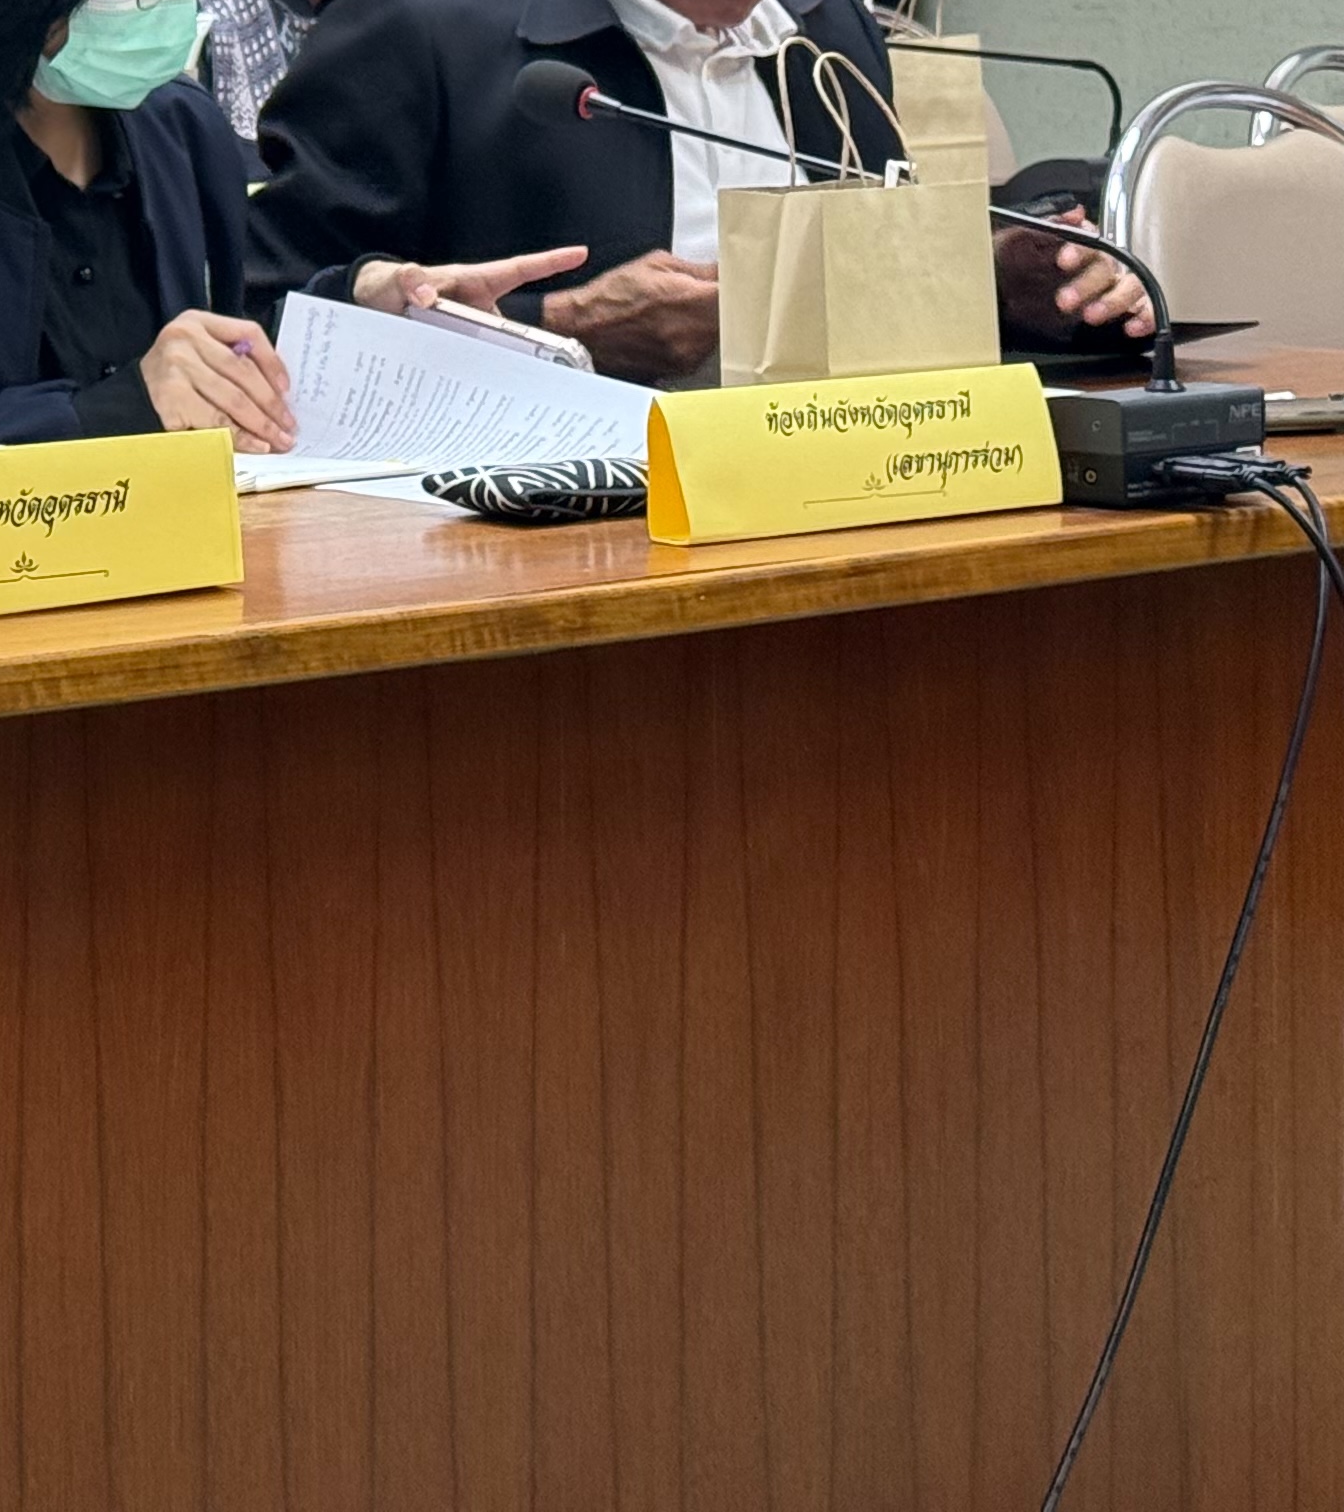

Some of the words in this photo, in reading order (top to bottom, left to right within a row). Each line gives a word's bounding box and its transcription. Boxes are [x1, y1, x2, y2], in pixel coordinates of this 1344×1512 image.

[765, 390, 971, 438] ท้องถิ่นจังหวัดอุดรธานี
[885, 441, 1024, 489] (เลขานุการร่วม)
